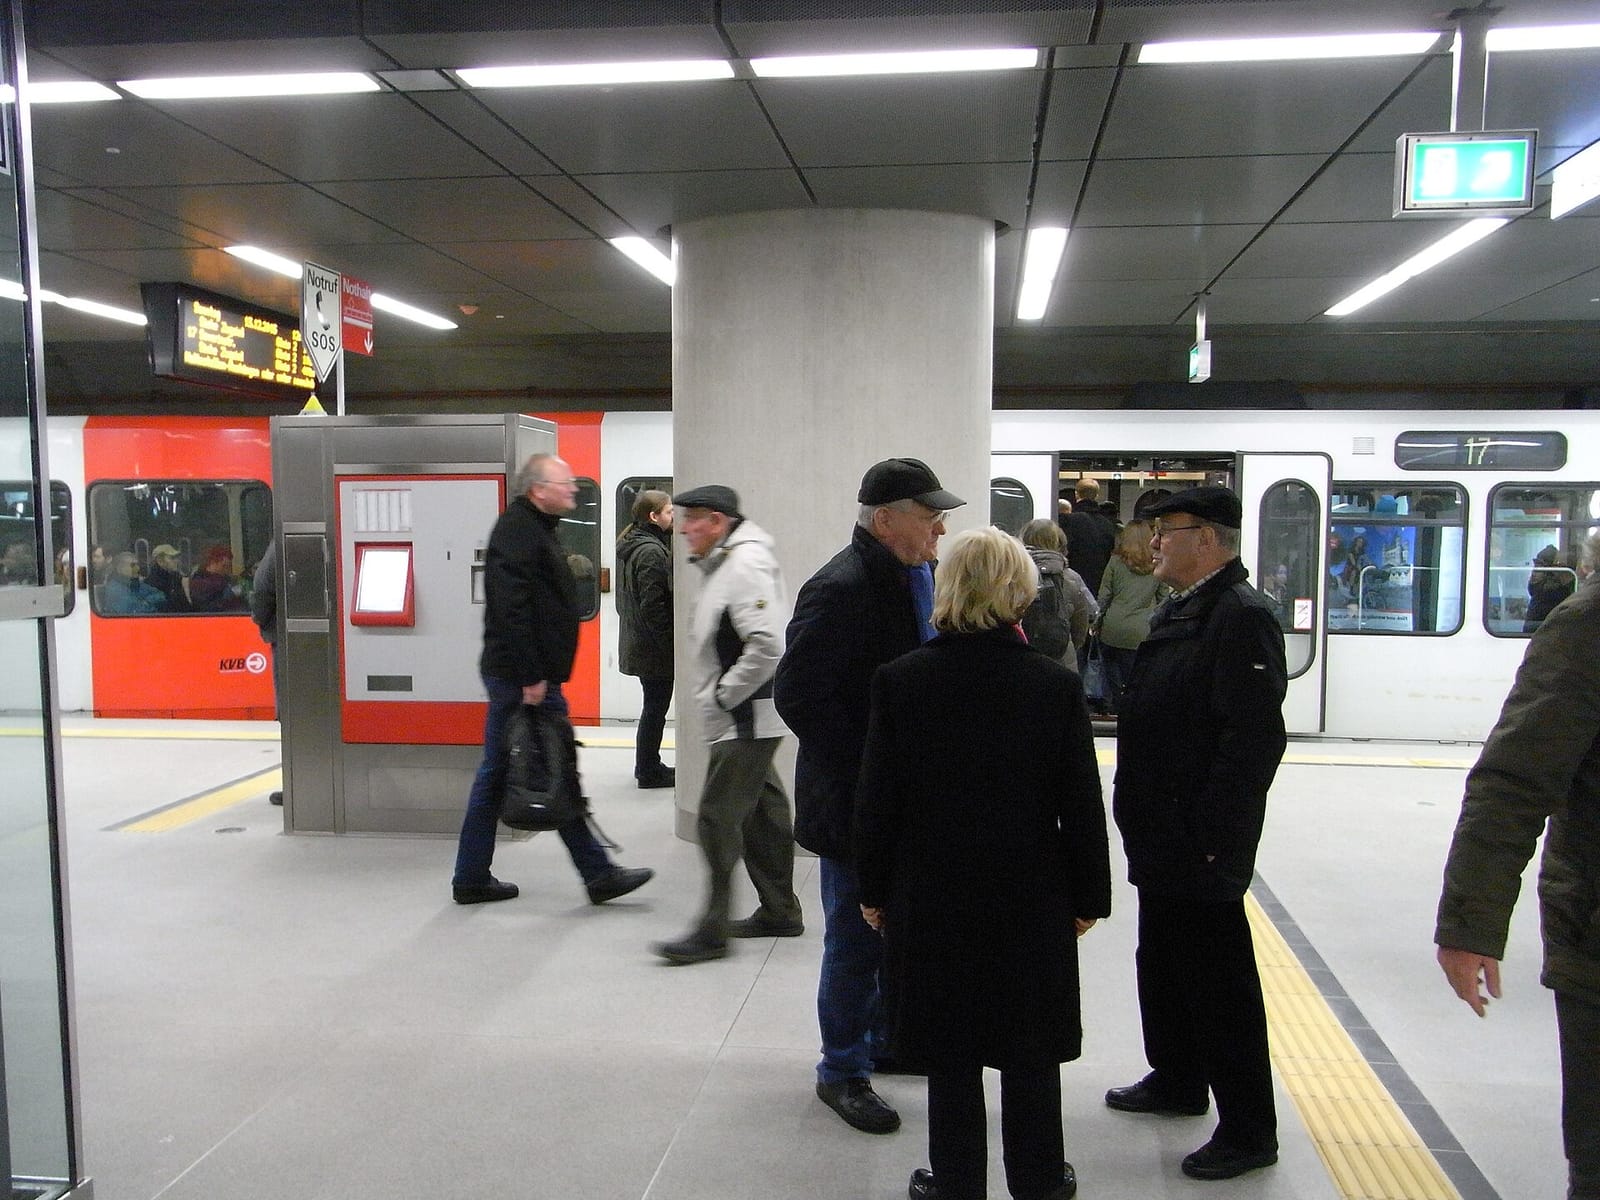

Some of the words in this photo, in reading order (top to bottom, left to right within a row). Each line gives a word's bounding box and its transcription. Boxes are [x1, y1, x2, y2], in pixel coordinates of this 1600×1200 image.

[307, 268, 338, 294] Notruf
[311, 331, 336, 352] SOS
[1466, 436, 1491, 465] 17
[219, 658, 246, 671] KVB
